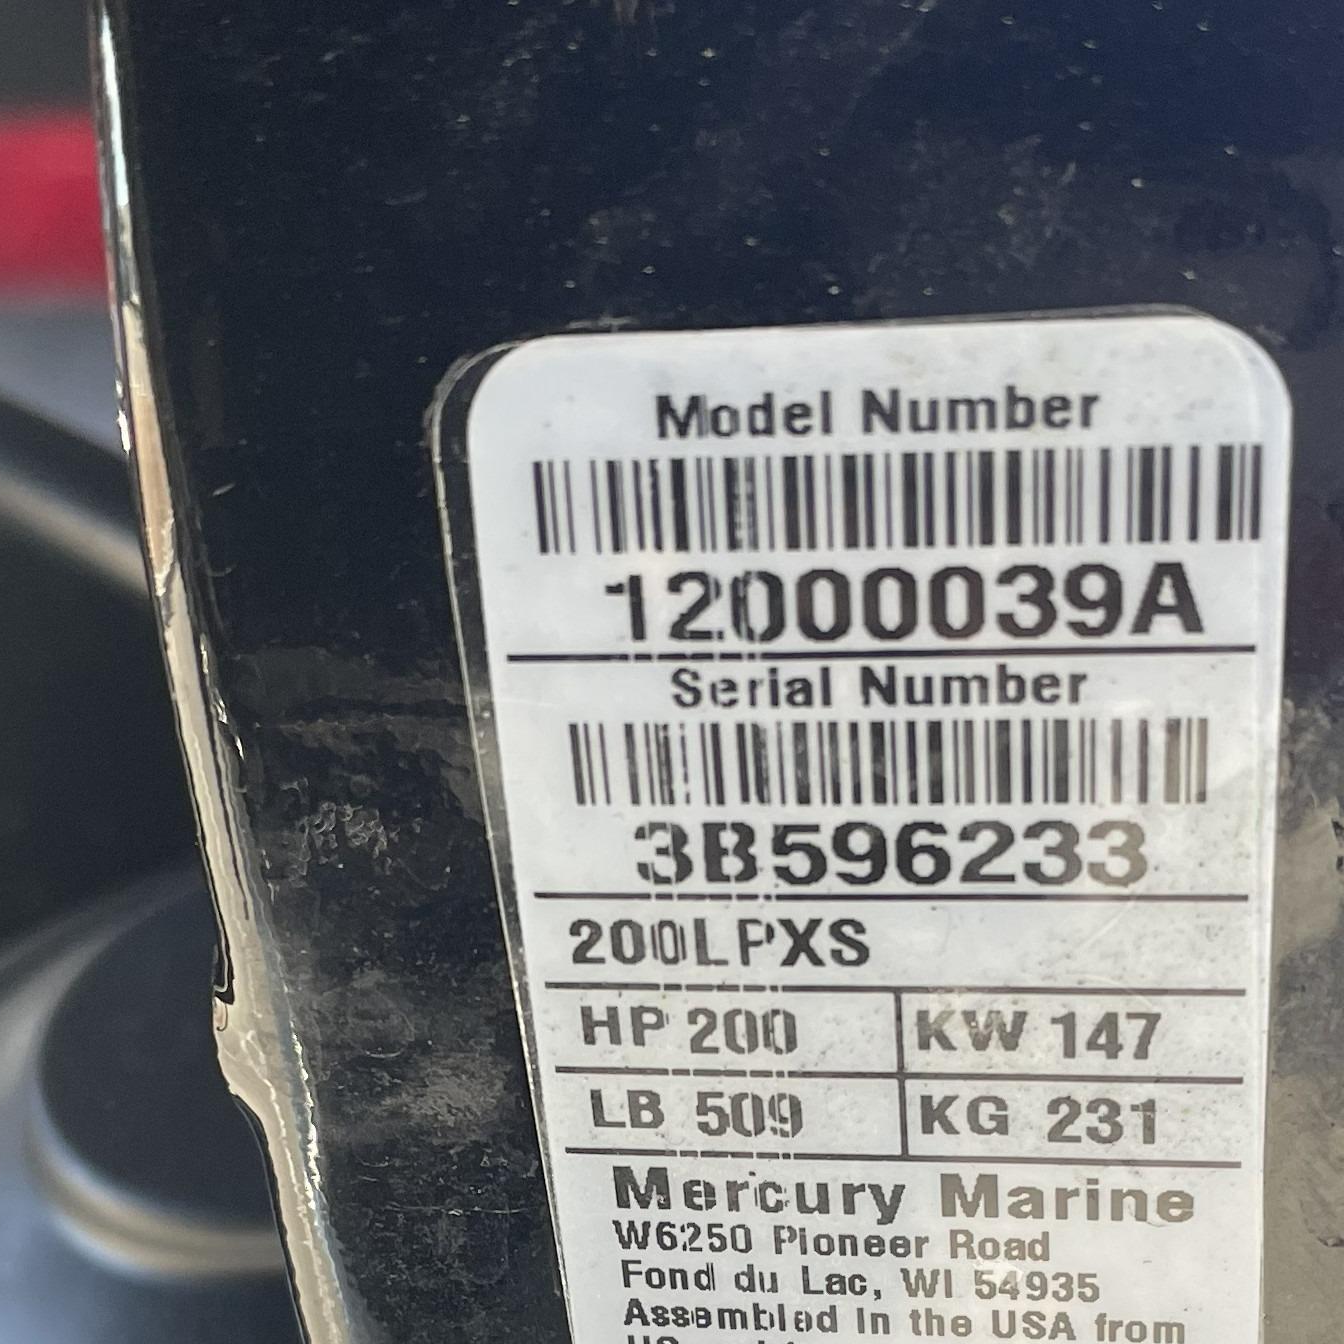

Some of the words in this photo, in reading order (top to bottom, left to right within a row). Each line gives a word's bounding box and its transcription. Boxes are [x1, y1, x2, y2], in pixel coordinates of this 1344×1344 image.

[657, 390, 833, 440] Model
[861, 386, 1101, 434] Number
[605, 562, 1205, 643] 12000039A
[672, 666, 832, 709] Serial
[861, 665, 1087, 706] Number
[636, 820, 1149, 886] 3B596233
[568, 917, 871, 968] 200LPXS
[580, 1005, 668, 1048] HP
[687, 1007, 798, 1057] 200
[917, 1010, 1027, 1052] KW
[1049, 1011, 1163, 1059] 147
[589, 1088, 665, 1130] LB
[695, 1090, 804, 1139] 509
[920, 1095, 1010, 1137] KG
[1046, 1096, 1158, 1145] 231
[612, 1165, 906, 1226] Mercury
[940, 1172, 1197, 1224] Marine
[612, 1219, 752, 1254] W6250
[774, 1225, 930, 1261] Pioneer
[950, 1228, 1051, 1263] Road
[621, 1259, 716, 1292] Fond
[733, 1263, 778, 1294] du
[800, 1264, 882, 1301] Lac,
[903, 1268, 954, 1299] WI
[973, 1268, 1100, 1303] 54935
[624, 1299, 838, 1335] Assembled
[910, 1308, 972, 1339] the
[991, 1308, 1076, 1341] USA
